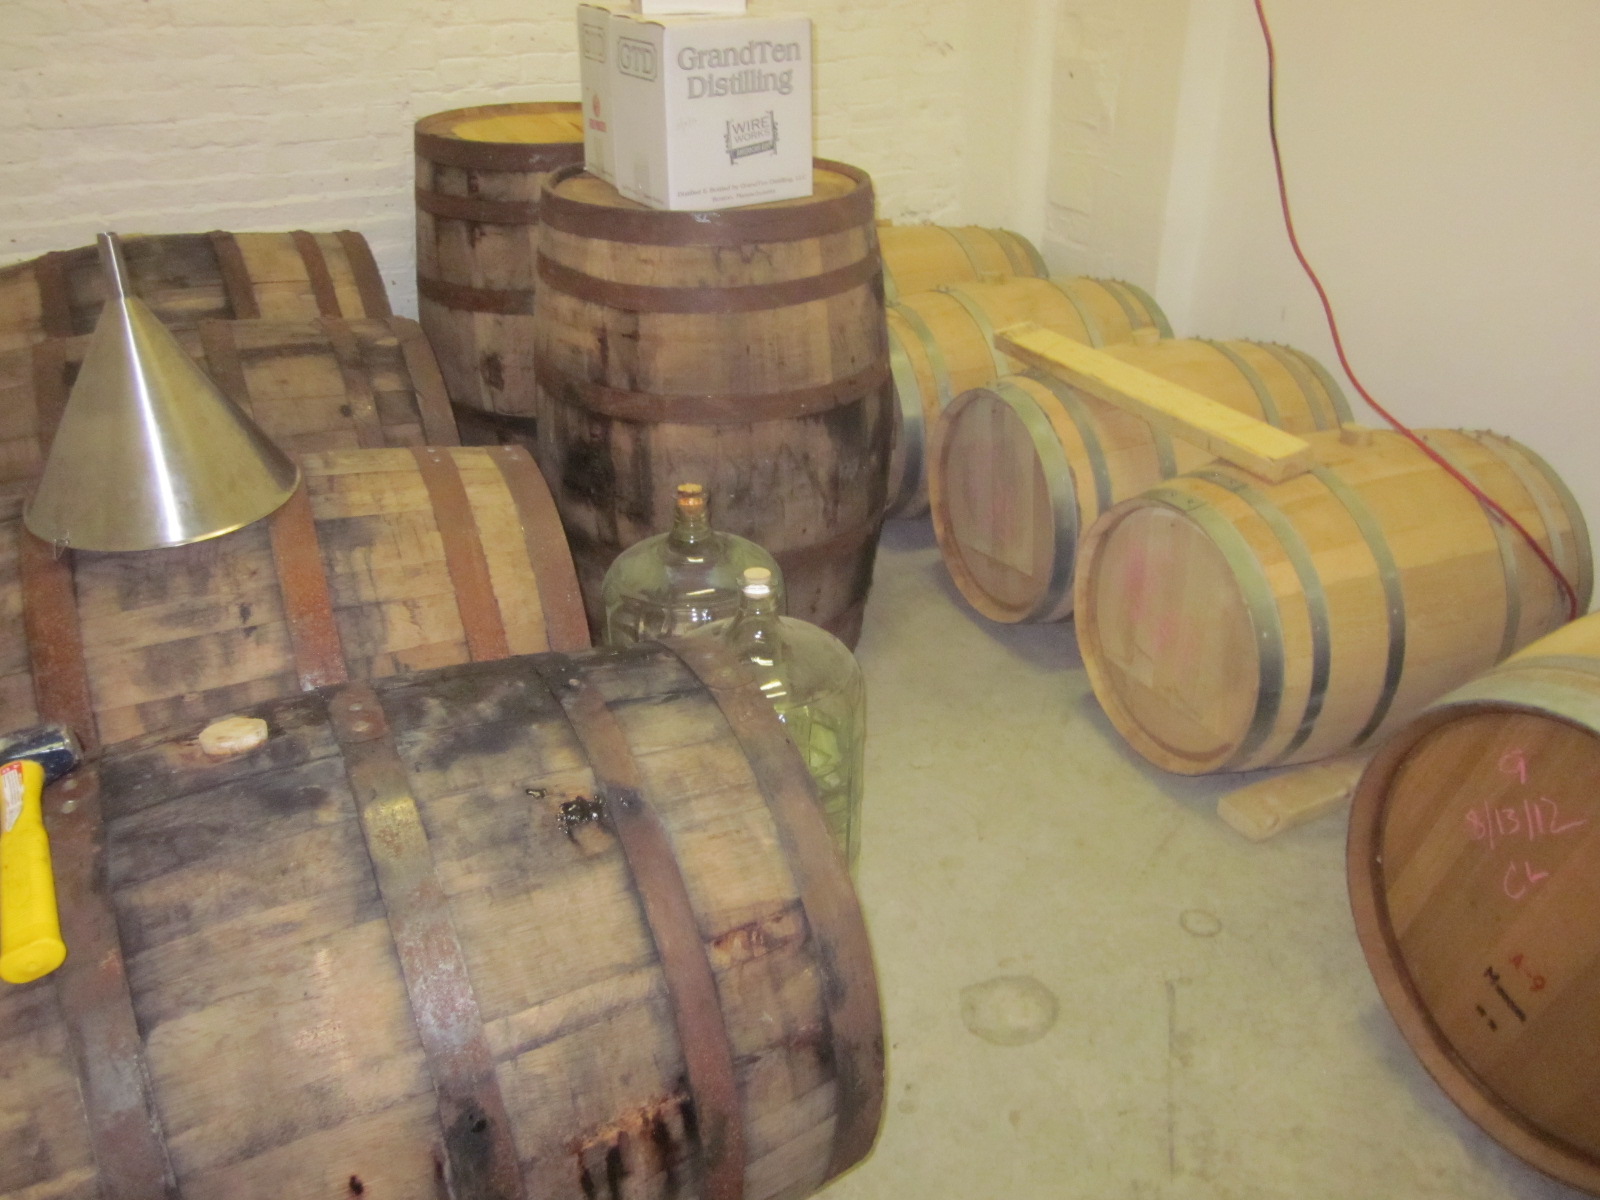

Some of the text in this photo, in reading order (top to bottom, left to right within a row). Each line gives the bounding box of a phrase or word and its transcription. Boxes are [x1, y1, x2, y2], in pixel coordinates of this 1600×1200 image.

[620, 43, 652, 75] GTD
[677, 40, 802, 70] GrandTen
[687, 69, 793, 99] Distilling
[732, 116, 769, 134] WIRE
[733, 129, 770, 143] WORKS
[1499, 749, 1526, 784] 9
[1466, 797, 1588, 850] 8/13/12
